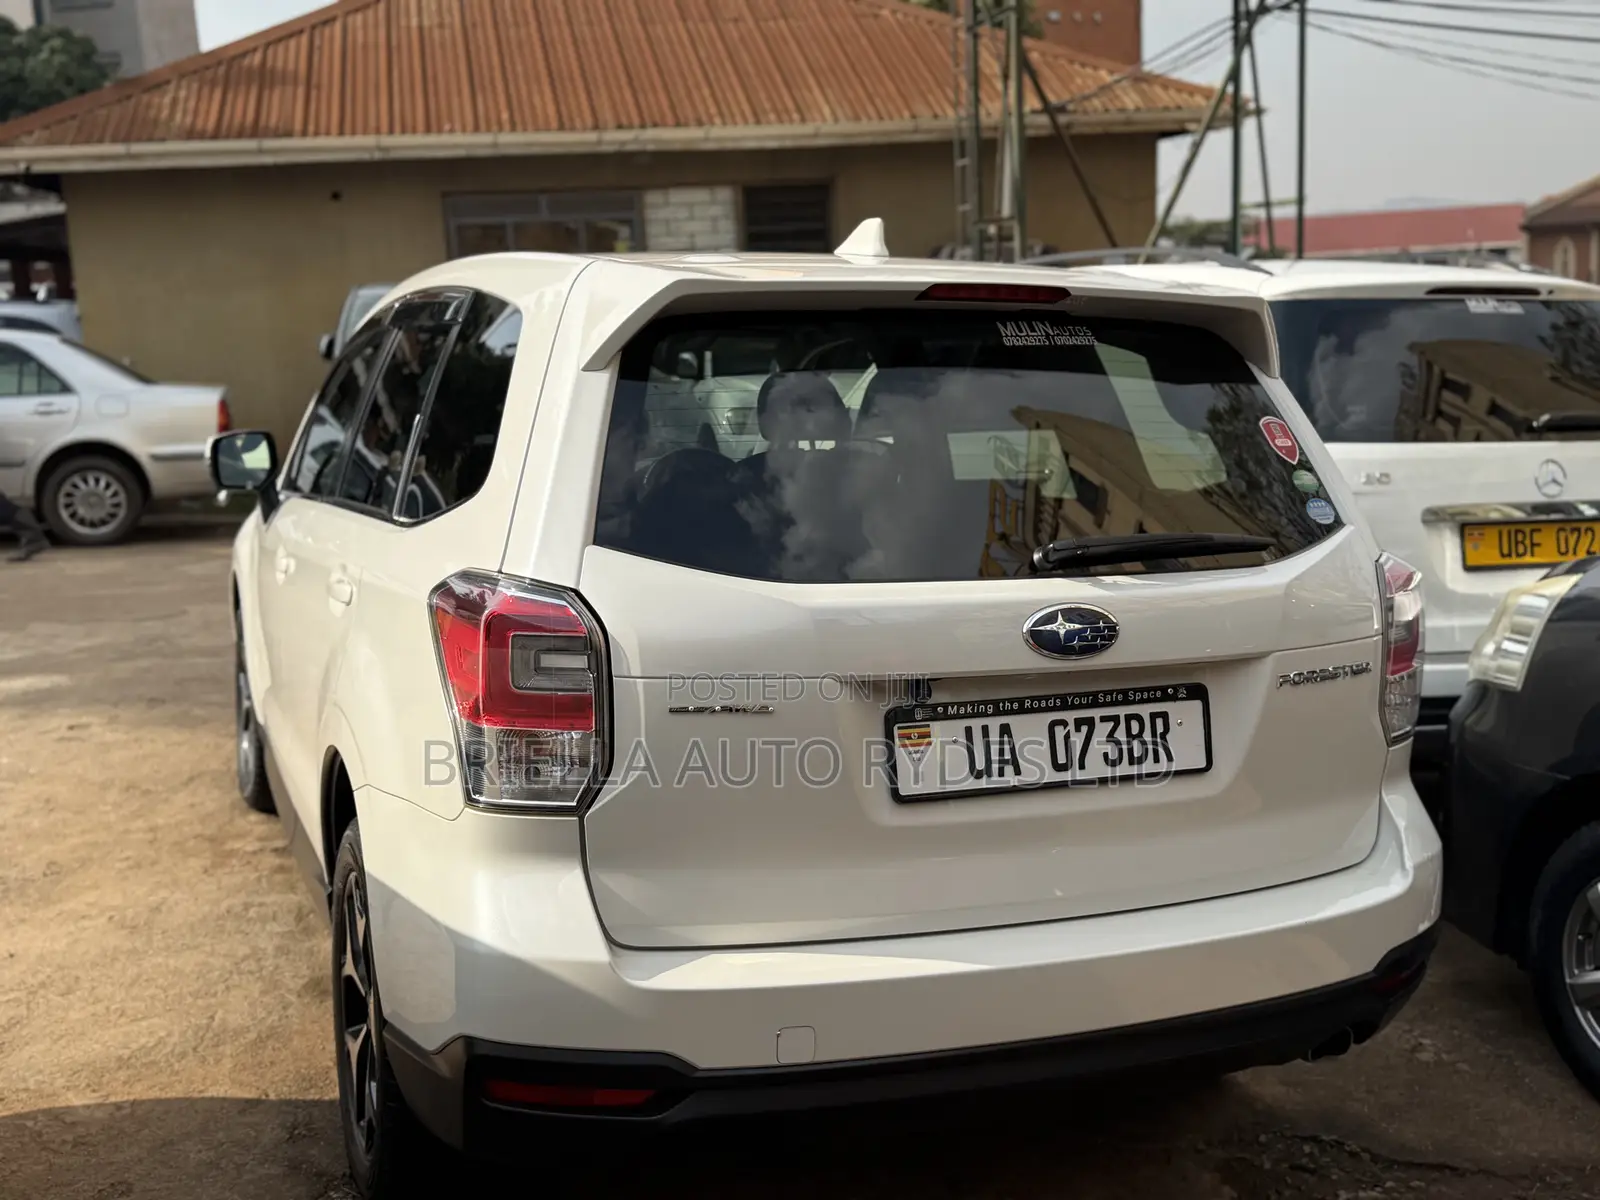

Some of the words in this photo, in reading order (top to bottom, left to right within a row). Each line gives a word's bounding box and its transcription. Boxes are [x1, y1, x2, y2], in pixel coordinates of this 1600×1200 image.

[1498, 528, 1542, 559] UBF
[1556, 526, 1597, 556] 072
[947, 704, 994, 715] Making
[999, 701, 1019, 711] the
[1024, 697, 1061, 709] Roads
[1067, 695, 1093, 706] Your
[1098, 691, 1123, 703] Safe
[1128, 689, 1162, 702] Space
[964, 723, 1022, 780] UA
[1048, 711, 1174, 772] 073BR
